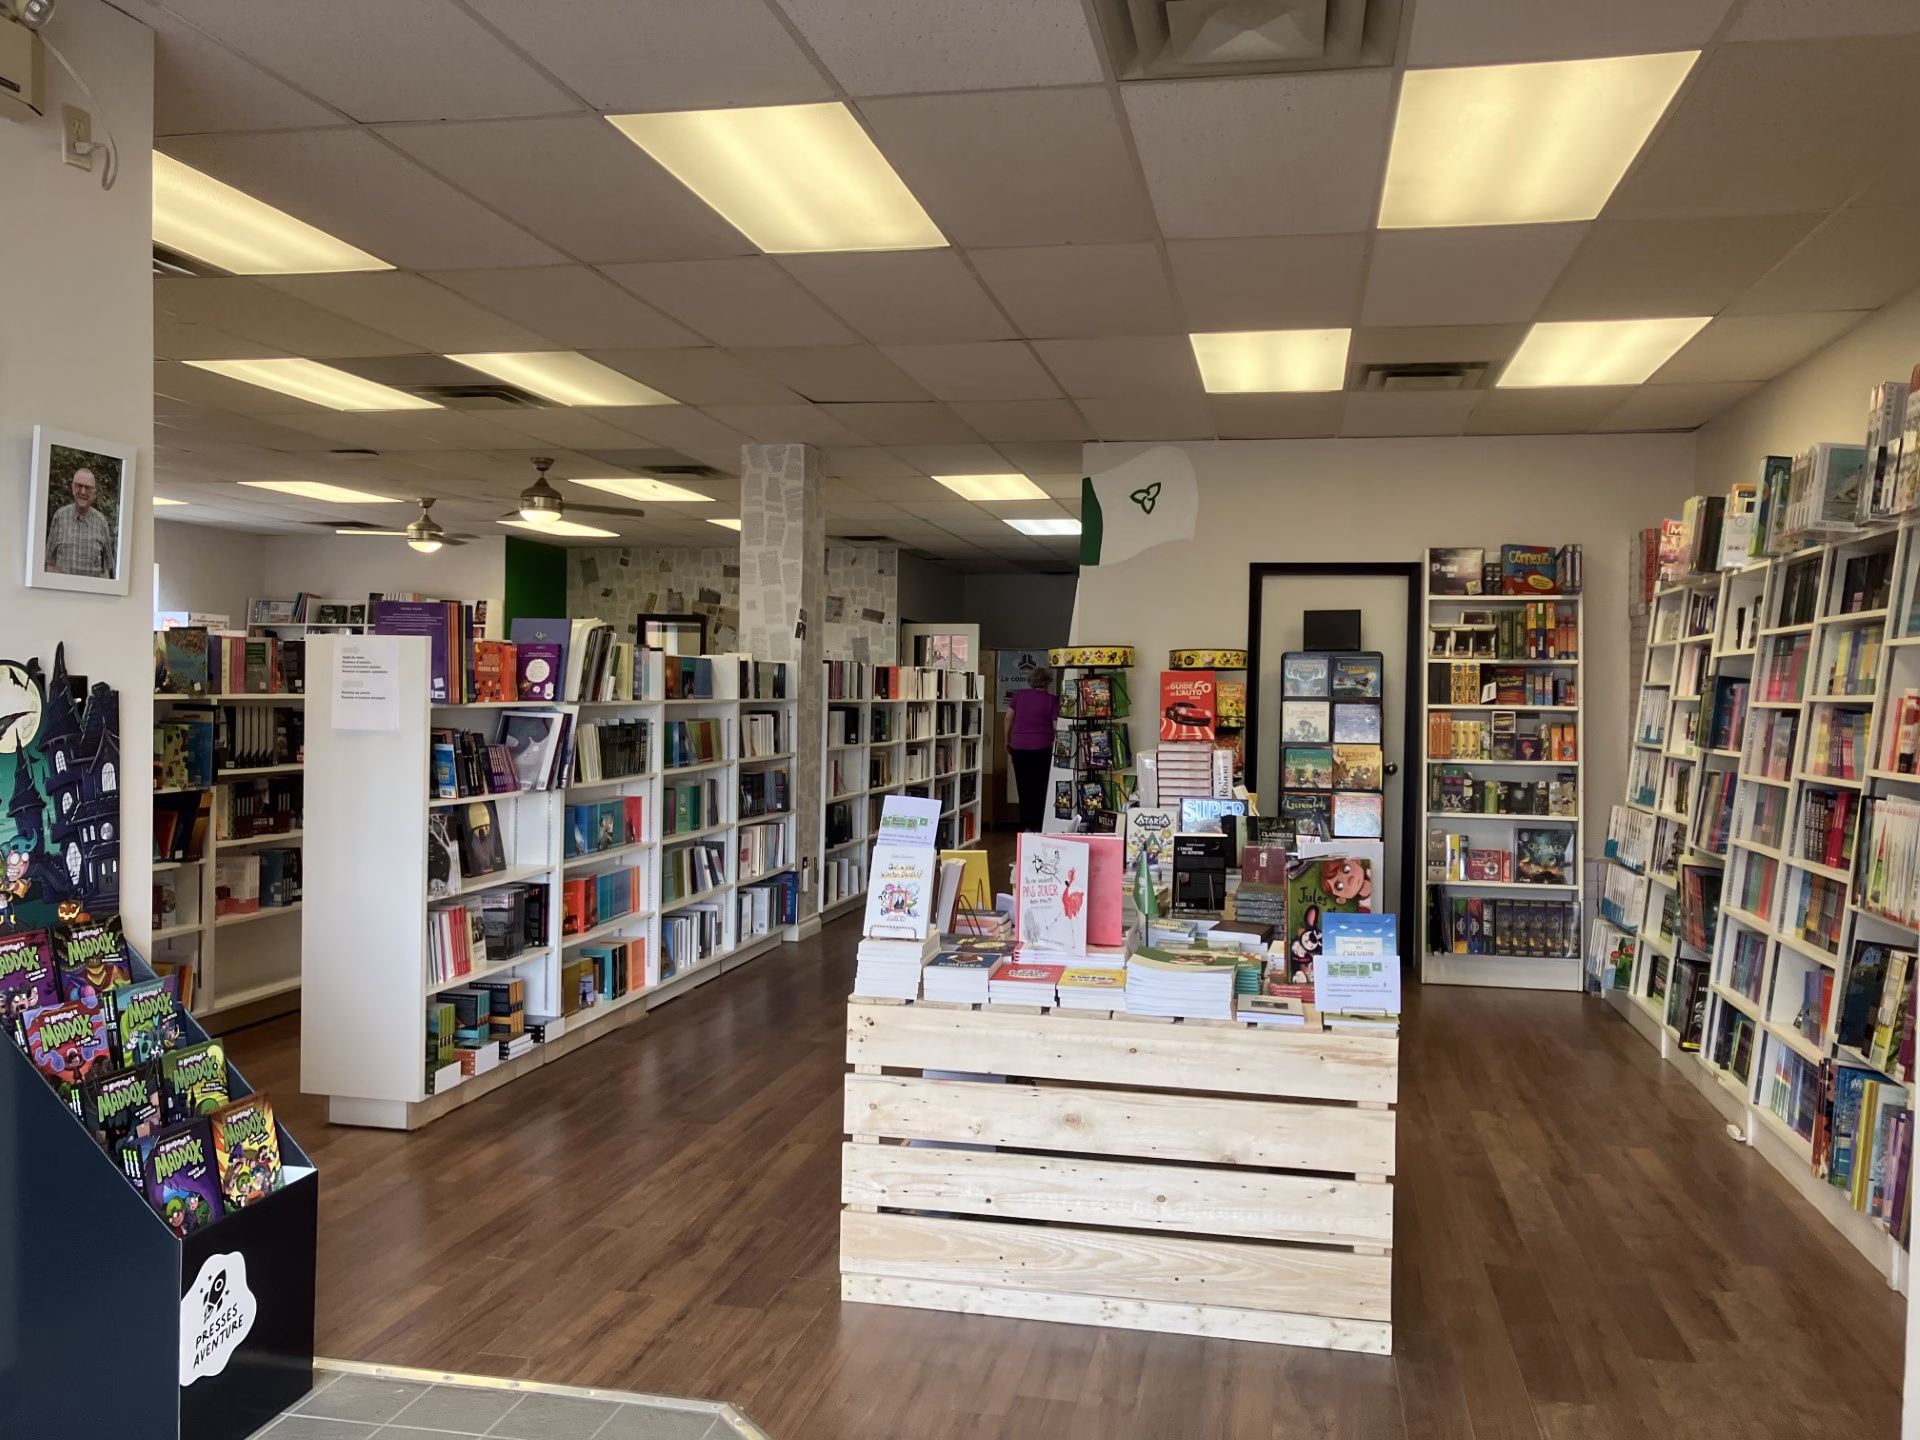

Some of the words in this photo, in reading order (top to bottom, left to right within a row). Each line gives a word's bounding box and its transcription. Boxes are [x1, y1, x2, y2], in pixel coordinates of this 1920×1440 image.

[1193, 680, 1212, 694] 60
[1098, 816, 1114, 826] WELLS
[1183, 800, 1245, 822] SUPER
[1261, 831, 1294, 839] CLASSIQUES
[1023, 886, 1036, 897] PAS
[1038, 884, 1058, 897] JOUER
[1297, 886, 1328, 906] Jules
[0, 946, 40, 980] ADDOX
[67, 932, 117, 966] MADDOX
[128, 992, 173, 1028] MADDOX
[40, 1014, 93, 1054] MADDOX
[174, 1055, 219, 1094] MADDOX
[97, 1080, 148, 1123] MADDOX
[223, 1111, 267, 1152] MADDOX
[154, 1138, 204, 1184] MADDOX
[193, 1314, 243, 1369] AVENTURE
[195, 1303, 238, 1350] PRESSES
